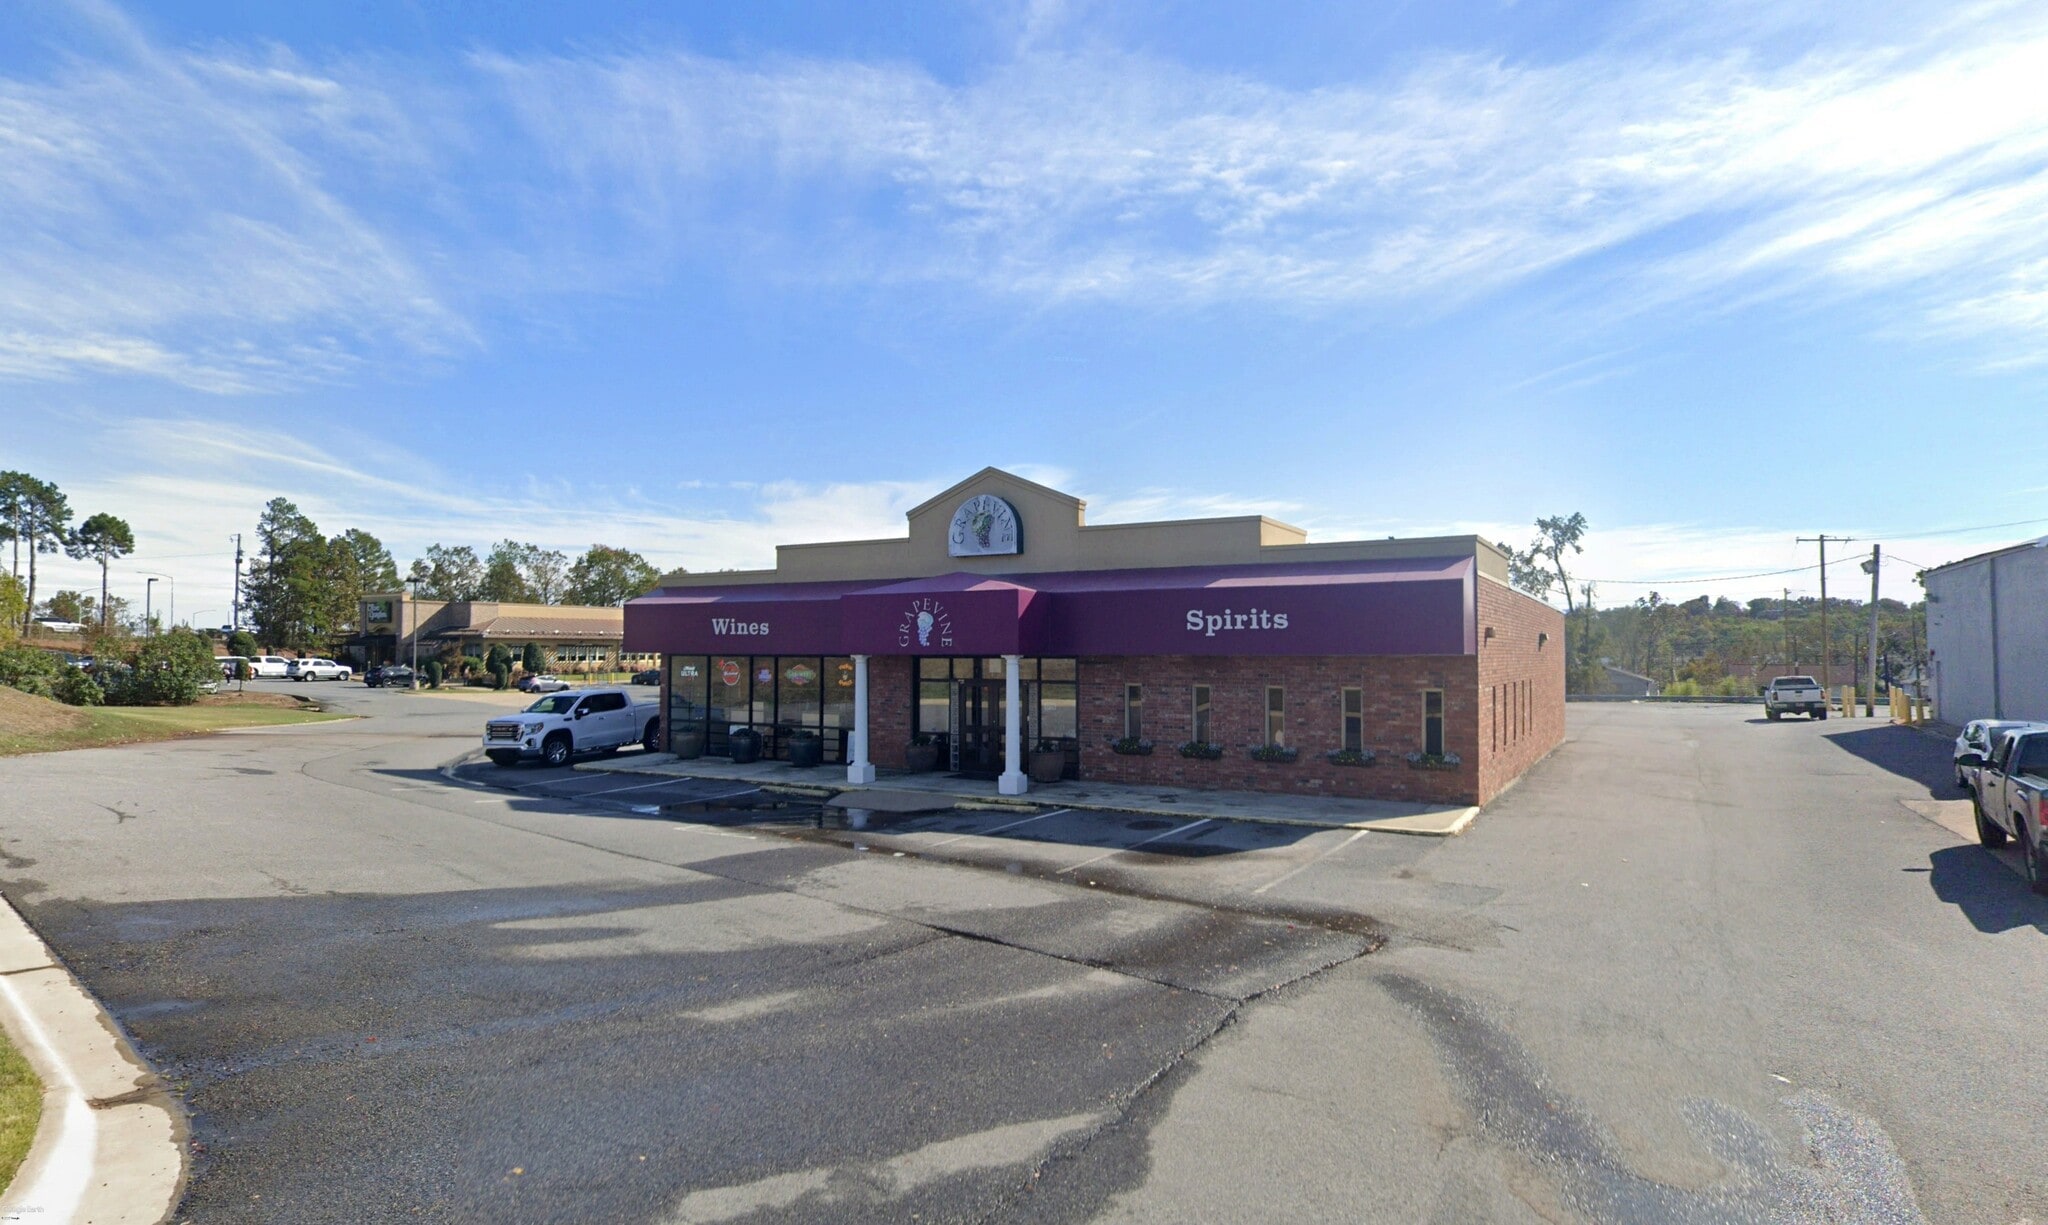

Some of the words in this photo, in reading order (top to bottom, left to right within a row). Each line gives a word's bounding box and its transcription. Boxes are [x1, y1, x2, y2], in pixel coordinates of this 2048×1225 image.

[952, 496, 1014, 545] GRAPEVINE
[711, 618, 769, 636] Wines
[898, 597, 953, 648] GRAPEVINE
[1186, 608, 1289, 637] Spirits
